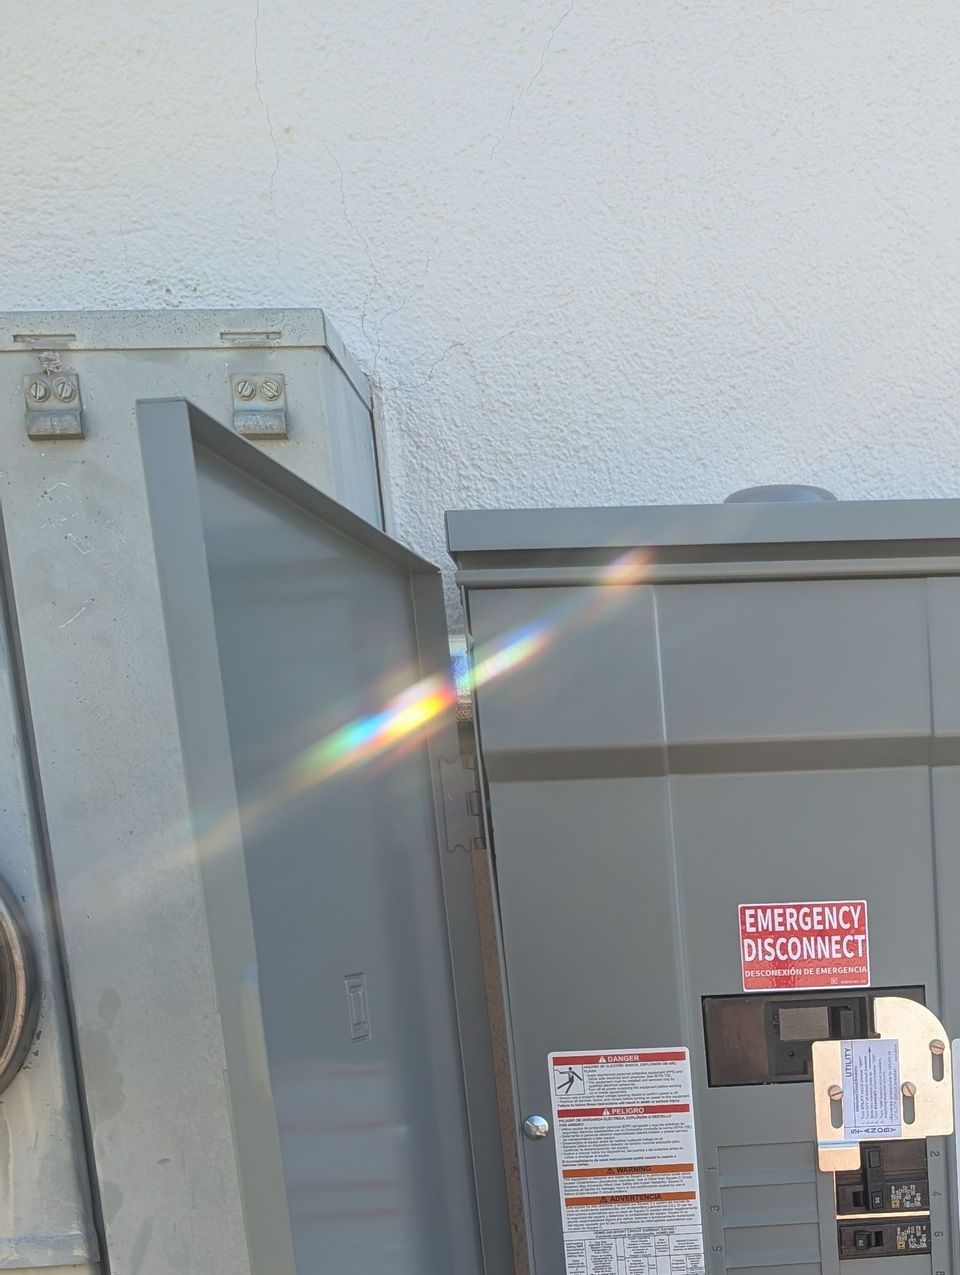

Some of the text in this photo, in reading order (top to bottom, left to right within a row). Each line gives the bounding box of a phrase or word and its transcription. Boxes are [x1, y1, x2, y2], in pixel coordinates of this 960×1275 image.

[745, 905, 861, 932] EMERGENCY
[743, 934, 865, 962] DISCONNECT
[745, 967, 802, 978] DESCONEXIÓN
[816, 965, 867, 975] EMERGENCIA
[610, 1194, 662, 1202] ADVERTENCIA
